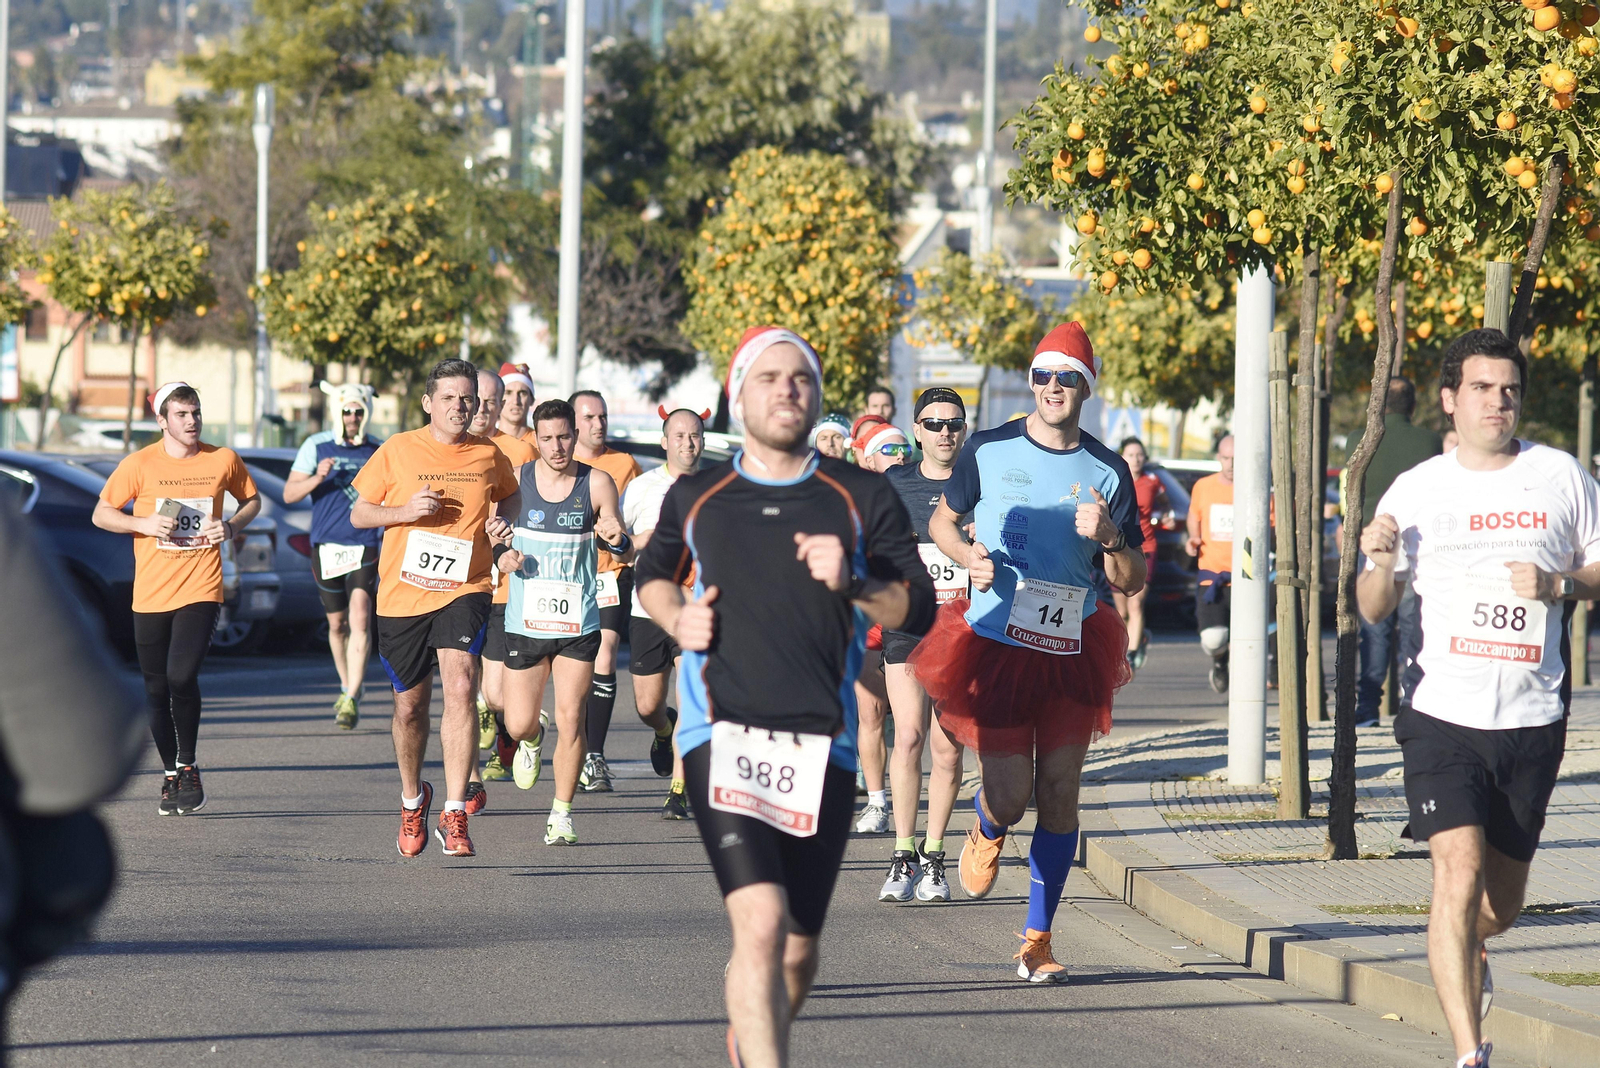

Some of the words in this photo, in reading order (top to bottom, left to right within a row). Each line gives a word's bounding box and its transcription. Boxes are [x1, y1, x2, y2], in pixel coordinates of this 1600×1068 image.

[1470, 511, 1547, 531] BOSCH
[1000, 538, 1025, 551] VERA
[1491, 541, 1513, 550] para
[1516, 539, 1526, 548] tu
[1529, 539, 1547, 548] vida
[418, 552, 456, 574] 977
[406, 572, 451, 589] Cruzcampo
[537, 597, 569, 615] 660
[1038, 604, 1064, 628] 14
[1472, 602, 1527, 632] 588
[528, 620, 570, 631] Cruzcampo
[1012, 627, 1066, 650] Cruzcampo
[1456, 638, 1527, 660] Cruzcampo
[737, 756, 795, 793] 988
[719, 788, 796, 826] Cruzcampo
